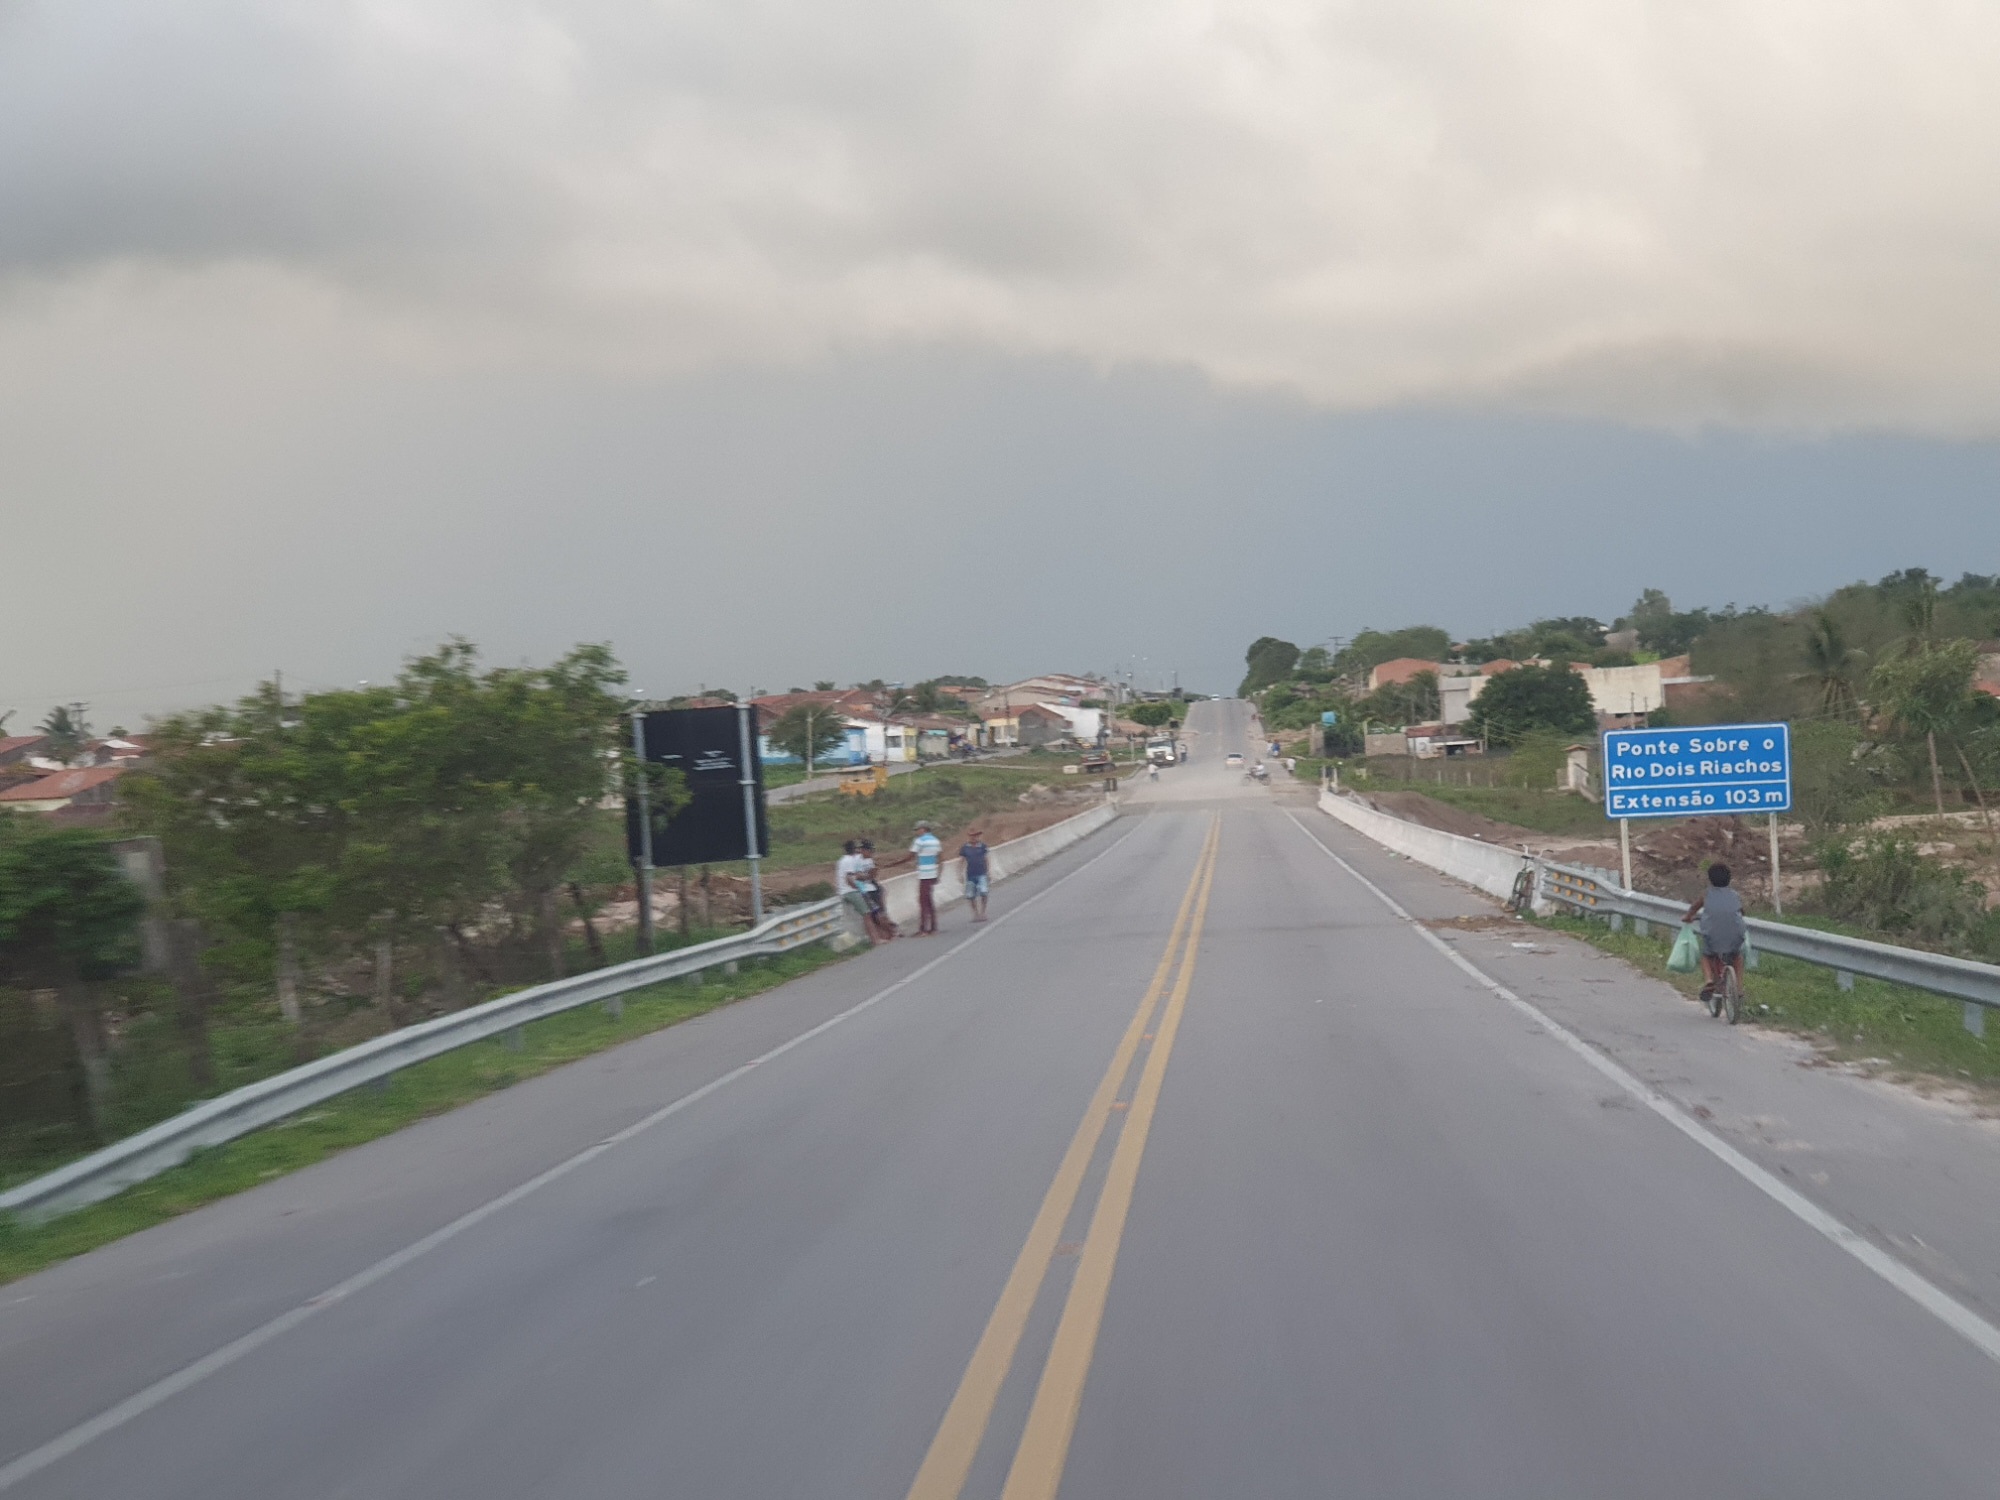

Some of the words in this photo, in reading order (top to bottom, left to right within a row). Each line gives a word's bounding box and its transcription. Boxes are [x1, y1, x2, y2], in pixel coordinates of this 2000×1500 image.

[1616, 739, 1680, 756] Ponte
[1689, 738, 1750, 753] Sobre
[1762, 738, 1775, 750] o
[1650, 761, 1696, 777] Dois
[1700, 758, 1782, 775] Riachos
[1612, 790, 1715, 809] Extensão
[1725, 789, 1761, 805] 103
[1765, 791, 1783, 803] m
